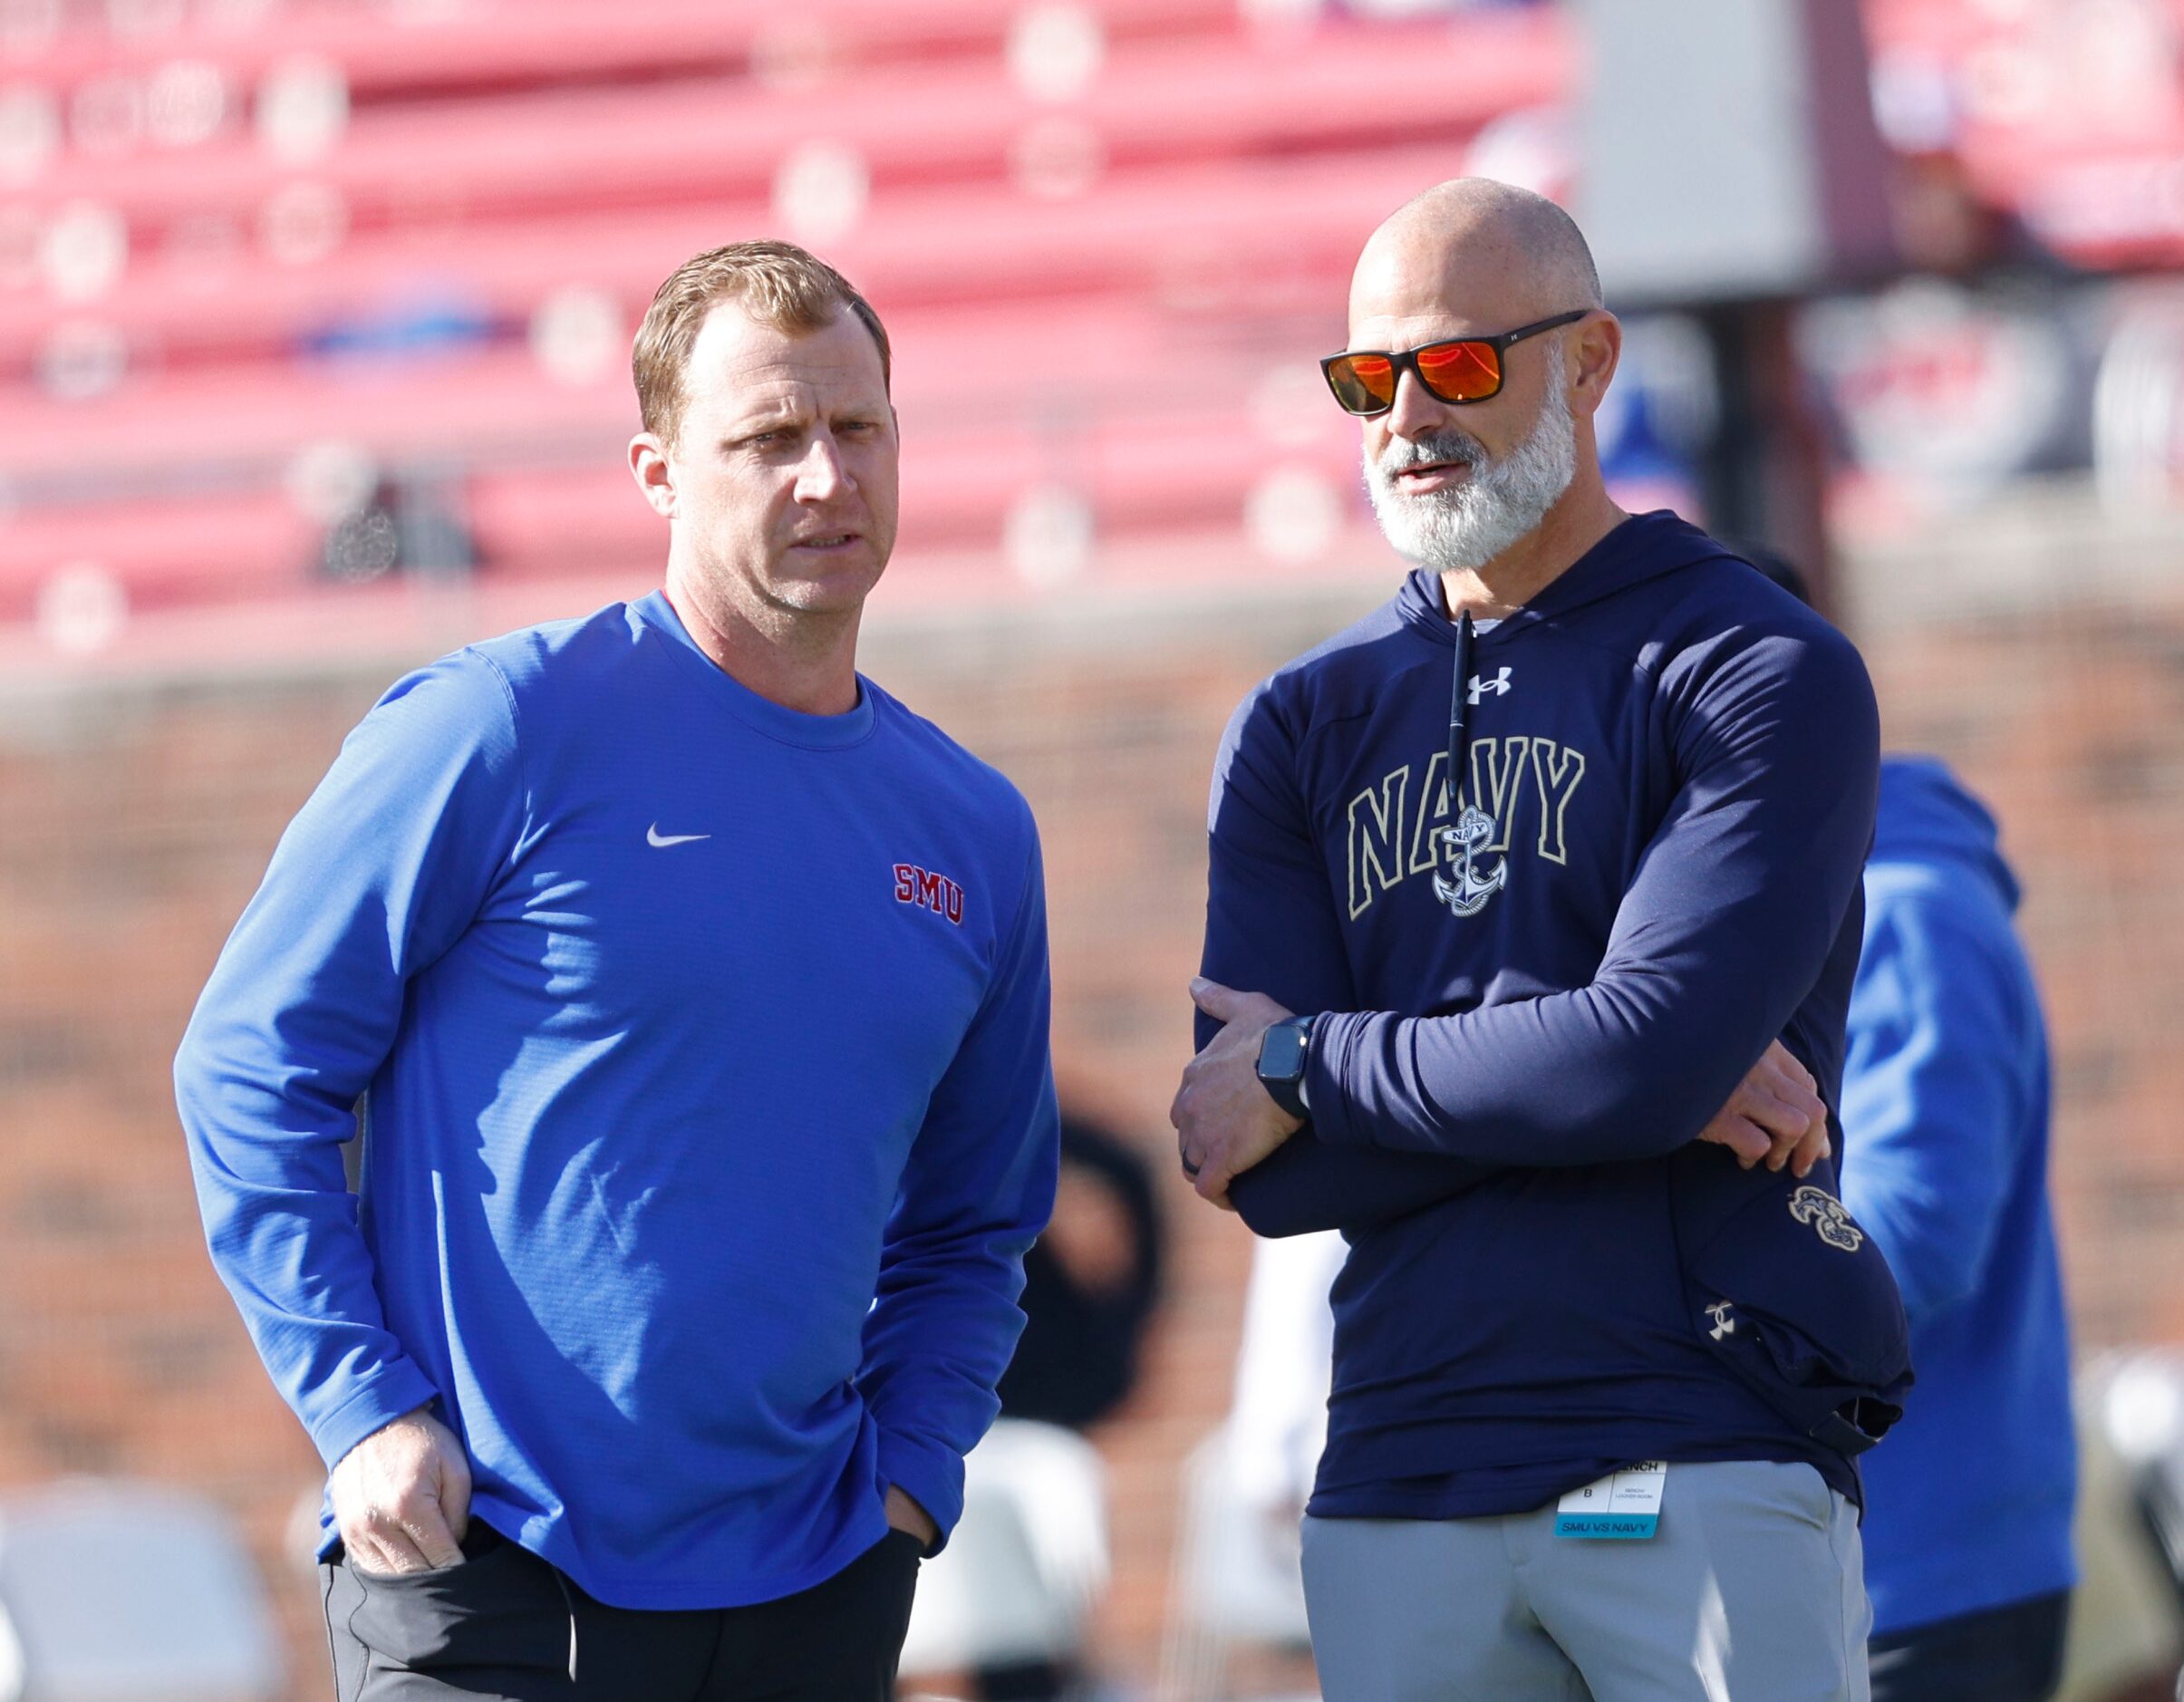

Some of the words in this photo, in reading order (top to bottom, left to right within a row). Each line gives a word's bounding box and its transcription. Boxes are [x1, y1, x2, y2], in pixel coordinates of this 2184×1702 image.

[1348, 736, 1586, 921] NAVY
[1452, 824, 1484, 840] NAVY
[893, 864, 964, 924] SMU
[1583, 1488, 1592, 1498] B
[1561, 1523, 1590, 1533] SMU
[1593, 1523, 1610, 1533] VS
[1612, 1523, 1648, 1533] NAVY
